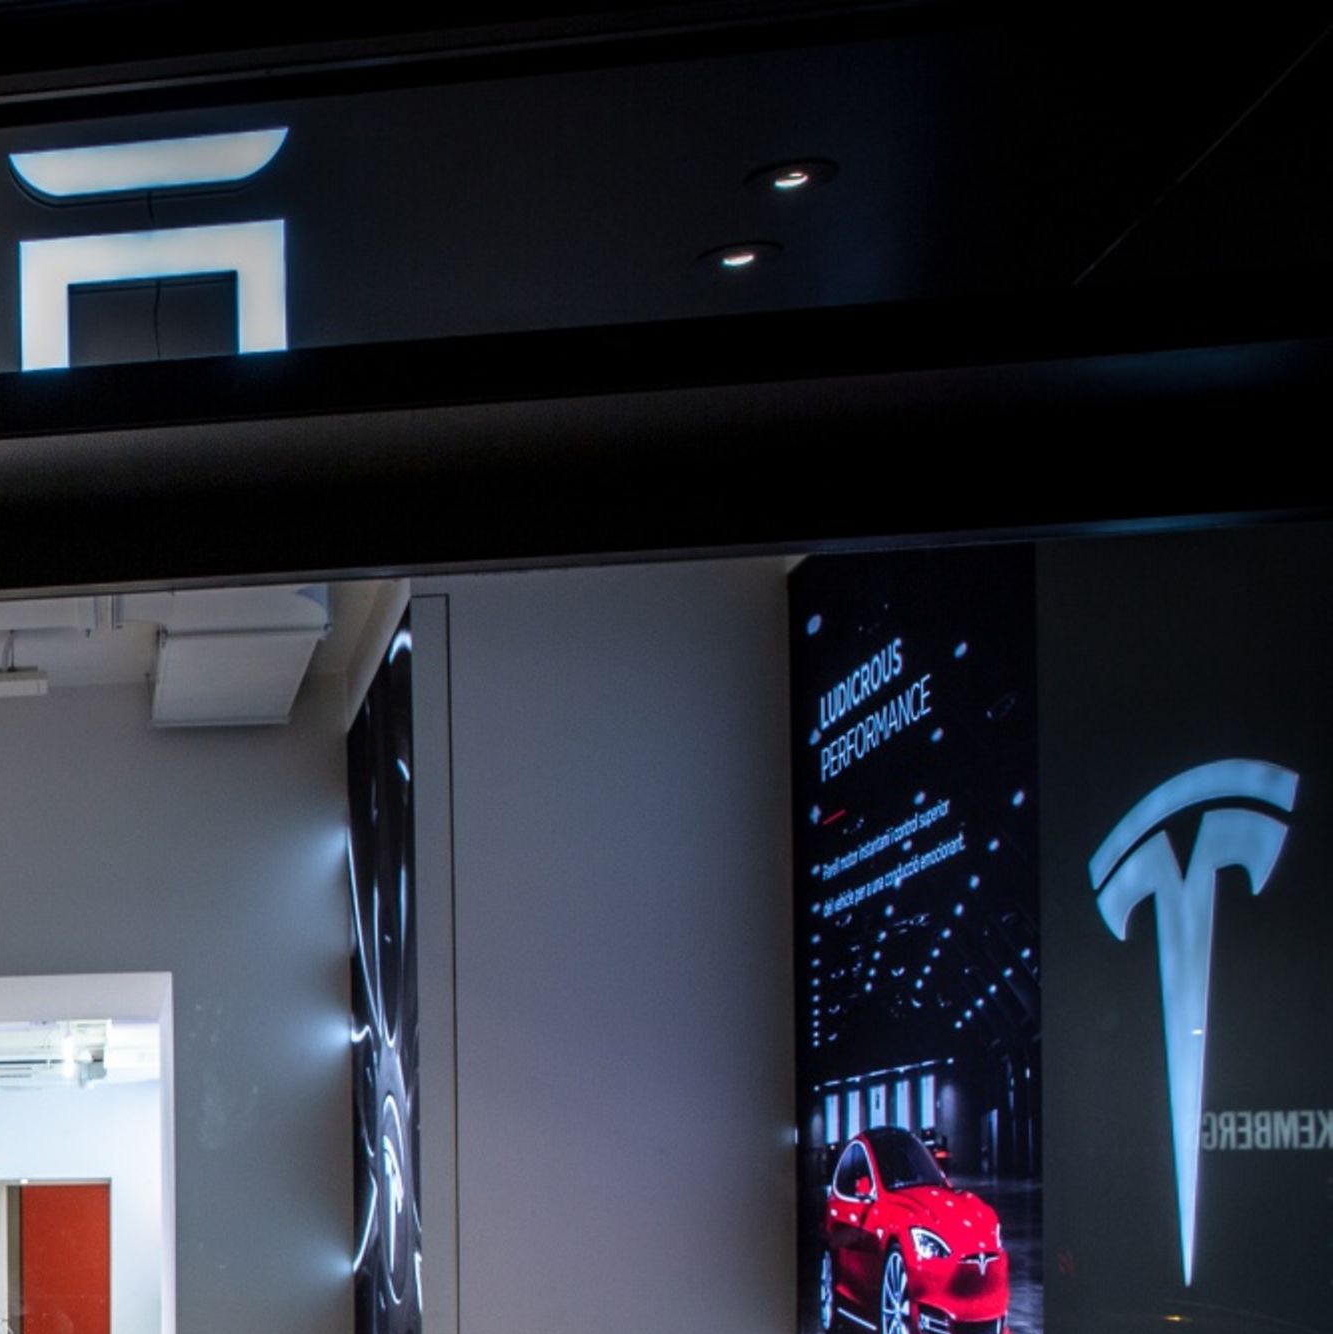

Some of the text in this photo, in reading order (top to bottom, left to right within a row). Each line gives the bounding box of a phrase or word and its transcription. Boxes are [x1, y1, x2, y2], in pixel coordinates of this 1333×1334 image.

[820, 637, 903, 731] LUDICROUS
[821, 673, 932, 783] PERFORMANCE
[894, 812, 918, 842] control
[919, 799, 950, 828] superior
[854, 885, 866, 906] per
[885, 854, 920, 887] conducció
[920, 831, 966, 869] emocionant.
